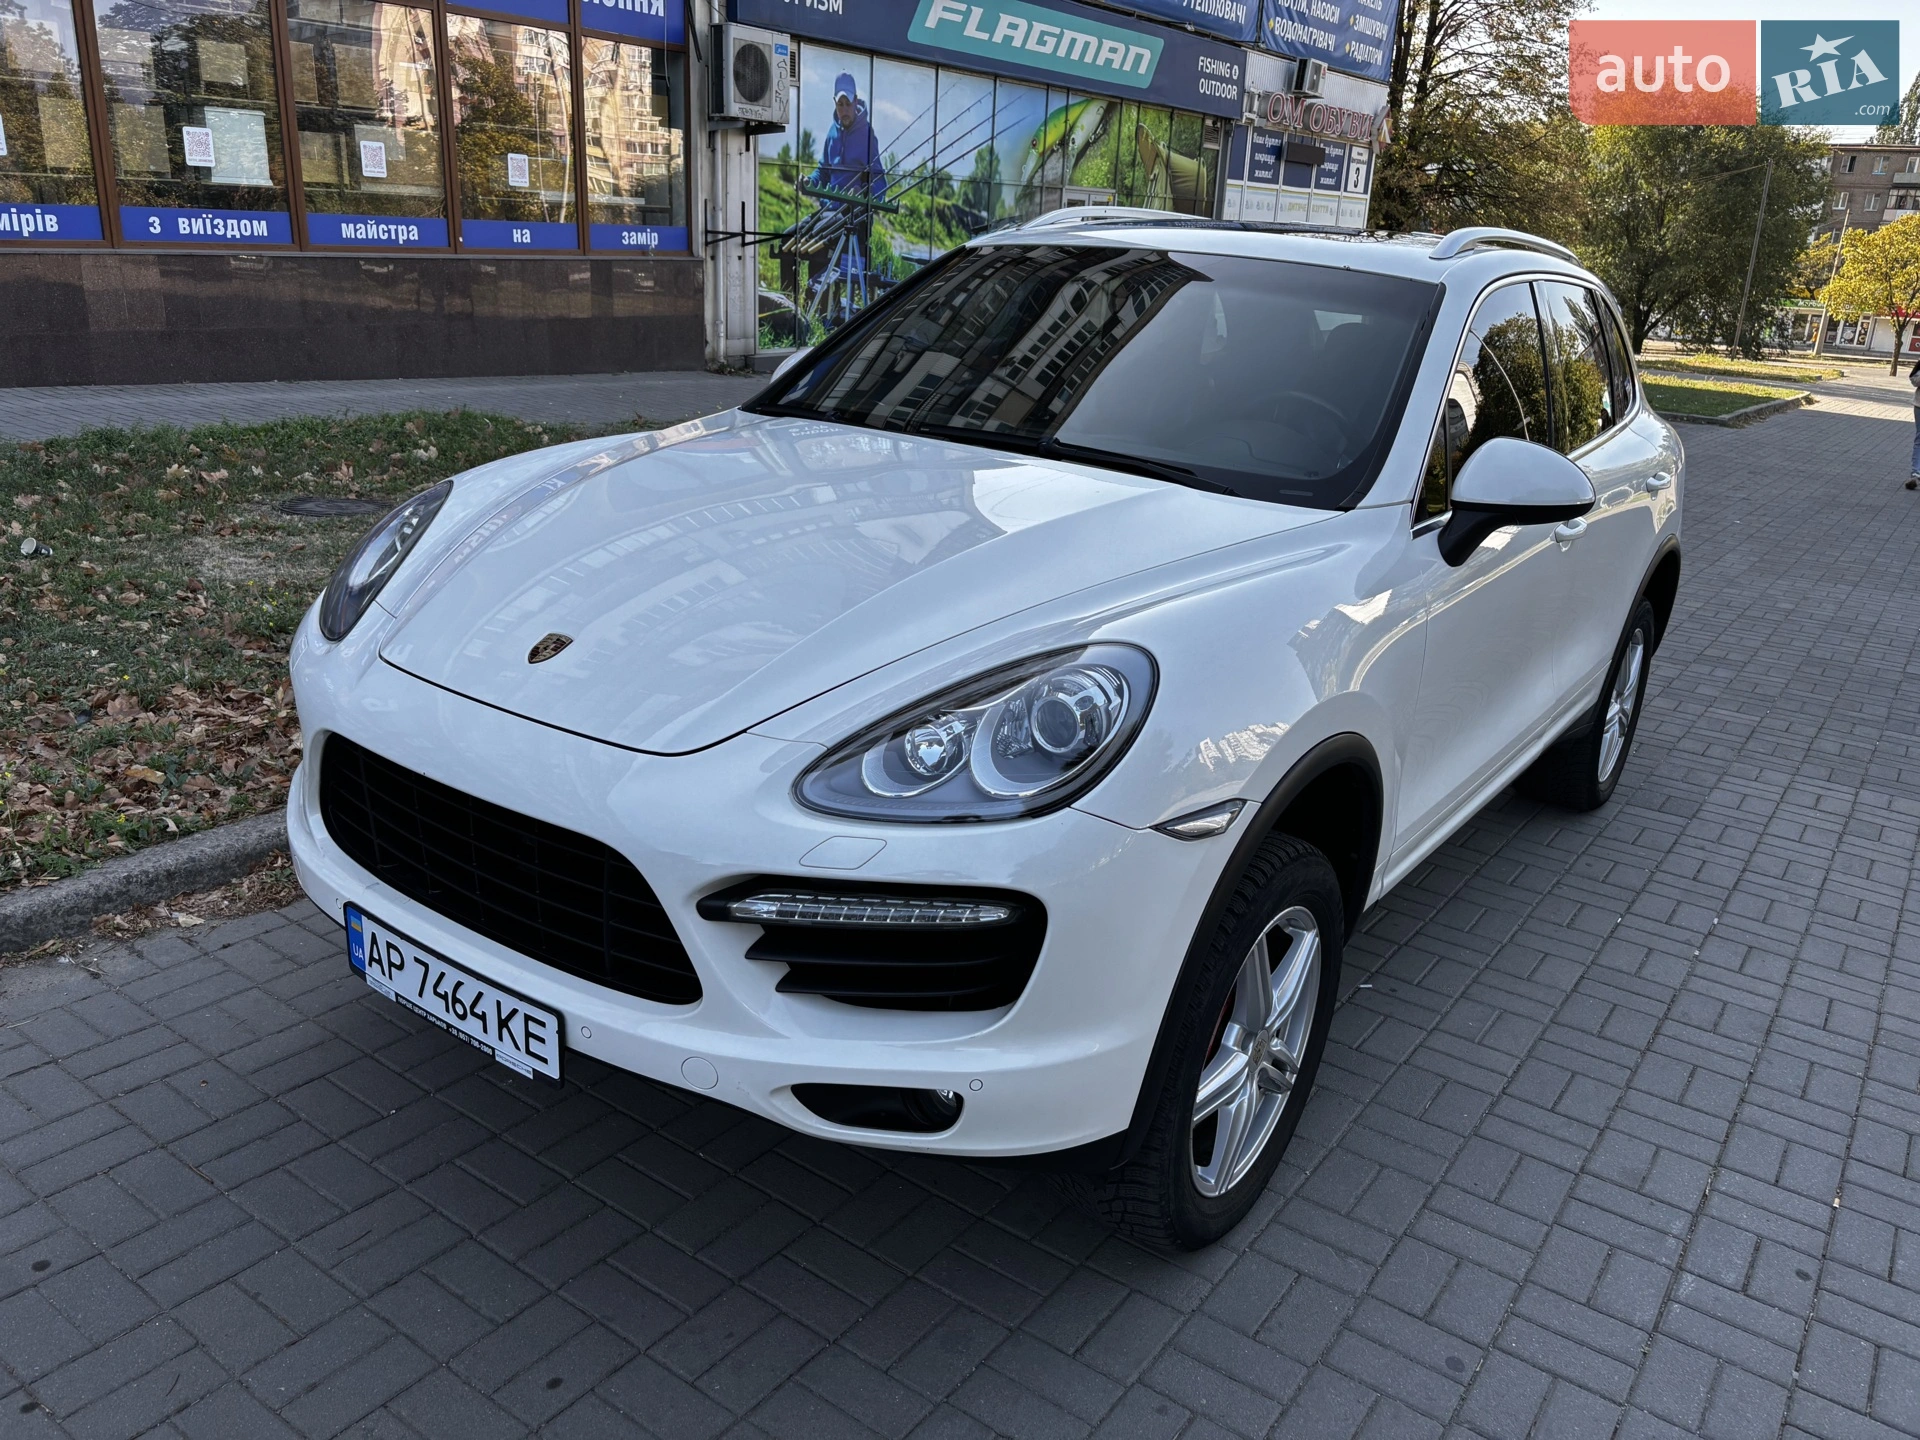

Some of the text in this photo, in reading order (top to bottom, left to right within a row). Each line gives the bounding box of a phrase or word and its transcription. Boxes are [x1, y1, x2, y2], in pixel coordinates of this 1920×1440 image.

[1310, 0, 1340, 24] НАСОСИ
[924, 0, 1152, 75] FLAGMAN
[1274, 17, 1336, 52] ВОДОНАГРІВАЧІ
[1353, 14, 1389, 41] ЗМІШУВАЧІ
[1198, 56, 1231, 76] FISHING
[1349, 41, 1383, 66] РАДІАТОРИ
[1199, 78, 1238, 100] OUTDOOR
[1310, 103, 1374, 142] ОБУВИ
[1353, 167, 1360, 189] 3
[178, 214, 268, 239] виїздом
[341, 219, 419, 245] майстра
[513, 228, 531, 244] на
[621, 228, 659, 248] замір
[353, 942, 364, 961] UA
[368, 931, 549, 1065] AP 7464 KE
